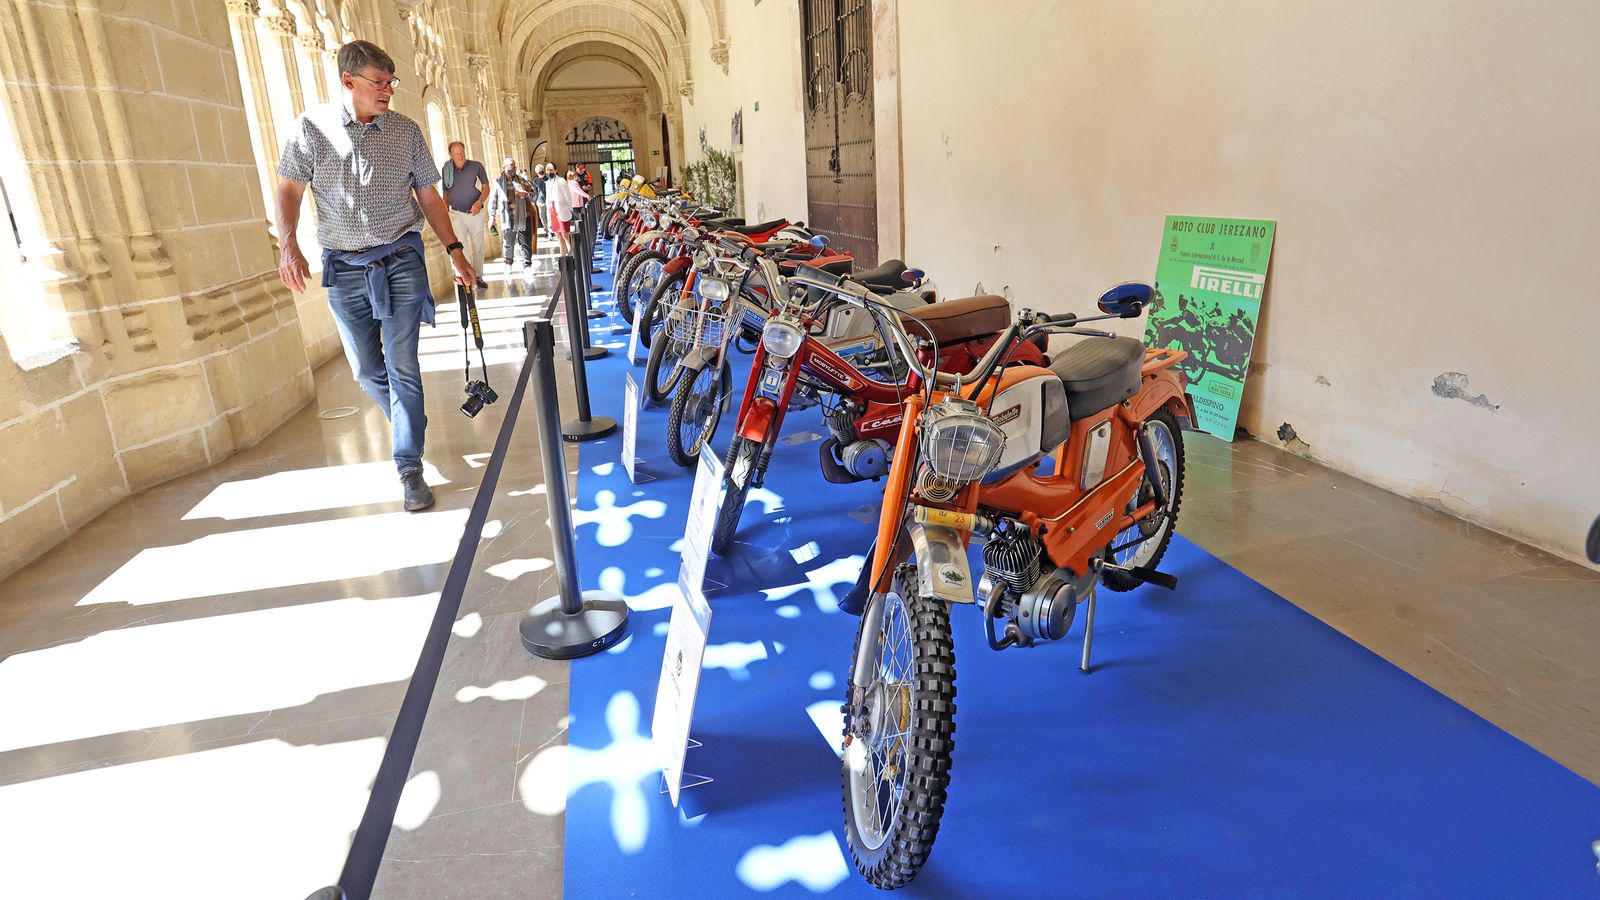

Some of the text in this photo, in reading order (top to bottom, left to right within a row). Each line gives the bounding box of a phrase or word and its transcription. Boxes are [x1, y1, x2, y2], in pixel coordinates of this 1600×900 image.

[1172, 221, 1266, 238] MOTO CLUB JEREZANO
[1190, 265, 1265, 299] PIRELLI
[813, 357, 846, 382] MOBYLETTE
[1193, 395, 1224, 411] ALDESPINO
[954, 515, 965, 523] 23
[592, 638, 606, 647] C-7
